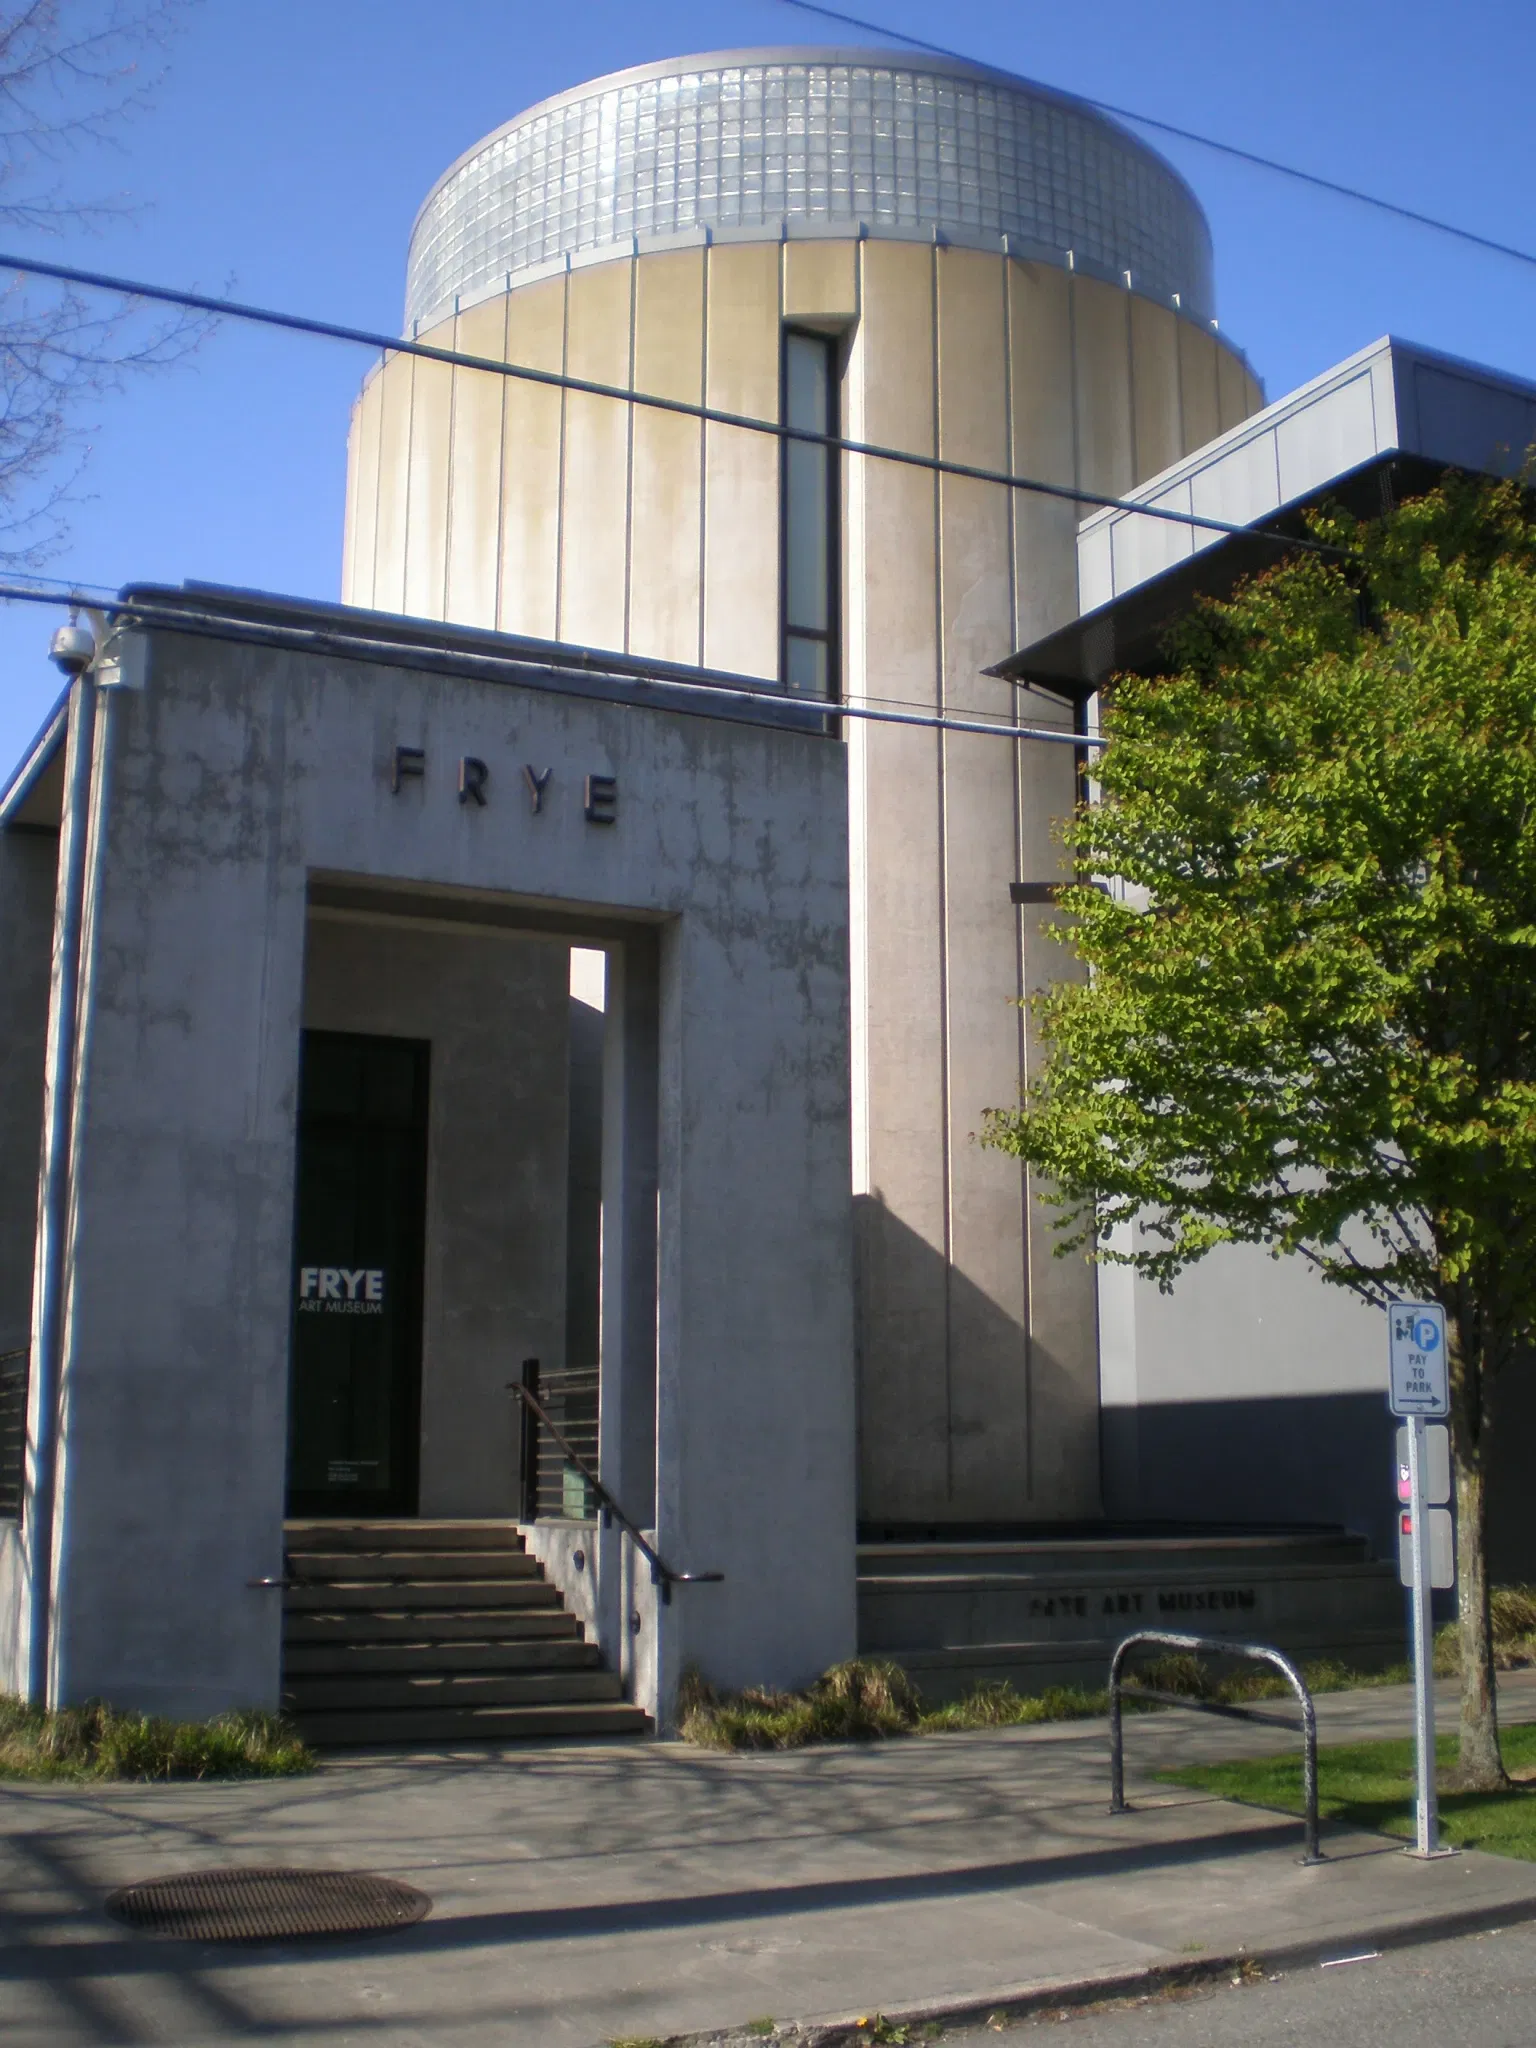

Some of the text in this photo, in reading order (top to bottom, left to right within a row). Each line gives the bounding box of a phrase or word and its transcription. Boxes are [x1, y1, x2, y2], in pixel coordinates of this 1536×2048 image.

[391, 745, 617, 824] FRYE
[300, 1267, 383, 1300] FRYE
[298, 1299, 383, 1315] ART MUSEUM
[1420, 1323, 1435, 1348] P
[1408, 1354, 1427, 1365] PAY
[1412, 1368, 1425, 1379] TO
[1406, 1382, 1432, 1393] PARK
[1102, 1593, 1143, 1614] ART
[1157, 1589, 1254, 1612] MUSEUM
